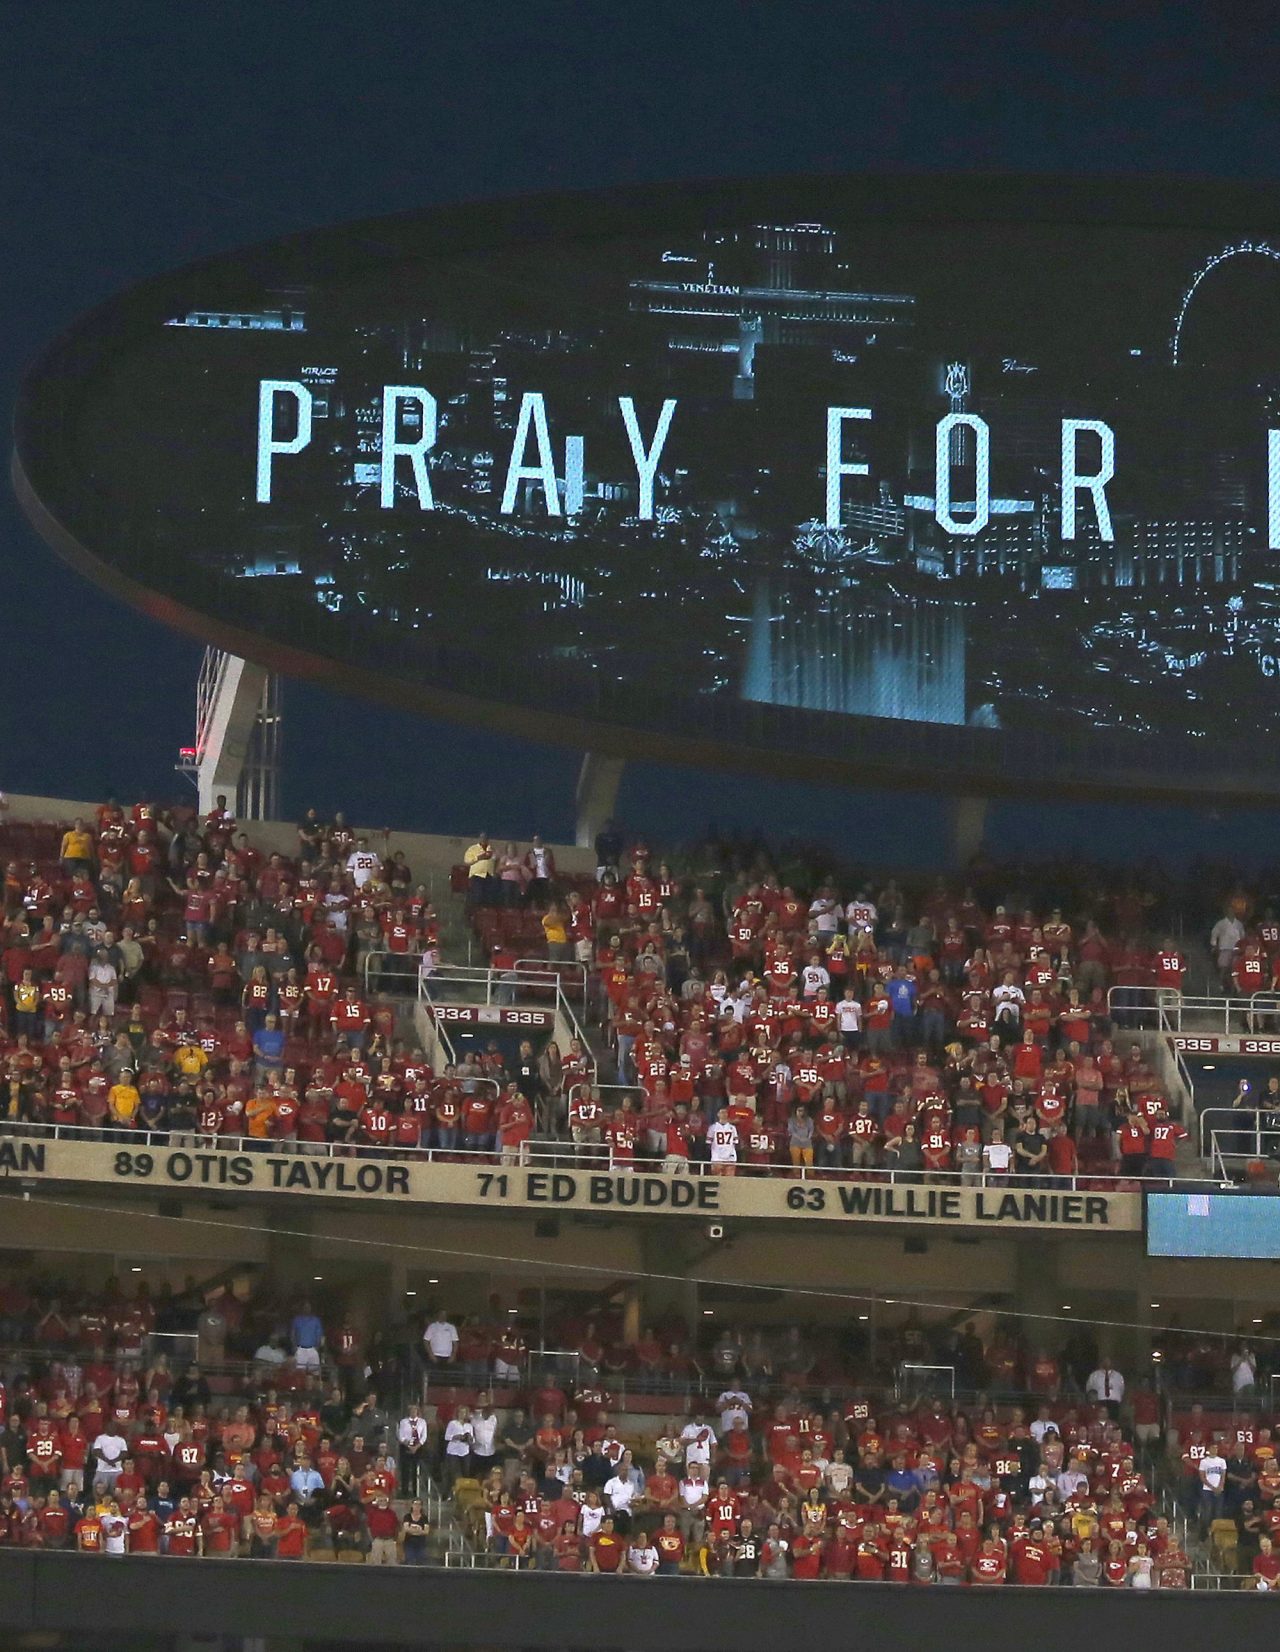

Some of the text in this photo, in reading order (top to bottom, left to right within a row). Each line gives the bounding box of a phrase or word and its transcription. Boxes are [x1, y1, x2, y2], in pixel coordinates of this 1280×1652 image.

[681, 283, 740, 295] VENETIAN
[256, 379, 678, 521] PRAY
[826, 407, 1115, 542] FOR
[357, 857, 373, 869] 22
[659, 884, 671, 896] 11
[638, 893, 652, 907] 15
[1262, 928, 1278, 941] 58
[774, 961, 789, 974] 35
[1162, 958, 1179, 971] 58
[1245, 961, 1260, 973] 29
[253, 985, 267, 998] 82
[316, 978, 331, 991] 17
[346, 1004, 360, 1018] 15
[433, 1008, 472, 1020] 334
[506, 1012, 545, 1024] 335
[815, 1004, 828, 1019] 19
[1175, 1039, 1212, 1051] 335
[799, 1068, 817, 1083] 56
[414, 1098, 426, 1111] 11
[444, 1104, 455, 1116] 11
[200, 1111, 216, 1126] 12
[371, 1116, 386, 1131] 10
[855, 1118, 872, 1134] 87
[715, 1131, 733, 1145] 87
[929, 1134, 944, 1148] 91
[113, 1151, 411, 1195] 89 OTIS TAYLOR
[476, 1173, 721, 1210] 71 ED BUDDE
[786, 1186, 1110, 1225] 63 WILLIE LANIER
[854, 1405, 868, 1418] 29
[800, 1420, 809, 1433] 11
[1237, 1430, 1254, 1444] 63
[37, 1441, 52, 1455] 29
[1190, 1446, 1206, 1460] 87
[181, 1448, 198, 1464] 87
[1111, 1463, 1120, 1478] 7
[524, 1500, 538, 1513] 11
[719, 1506, 733, 1520] 10
[891, 1552, 908, 1568] 31
